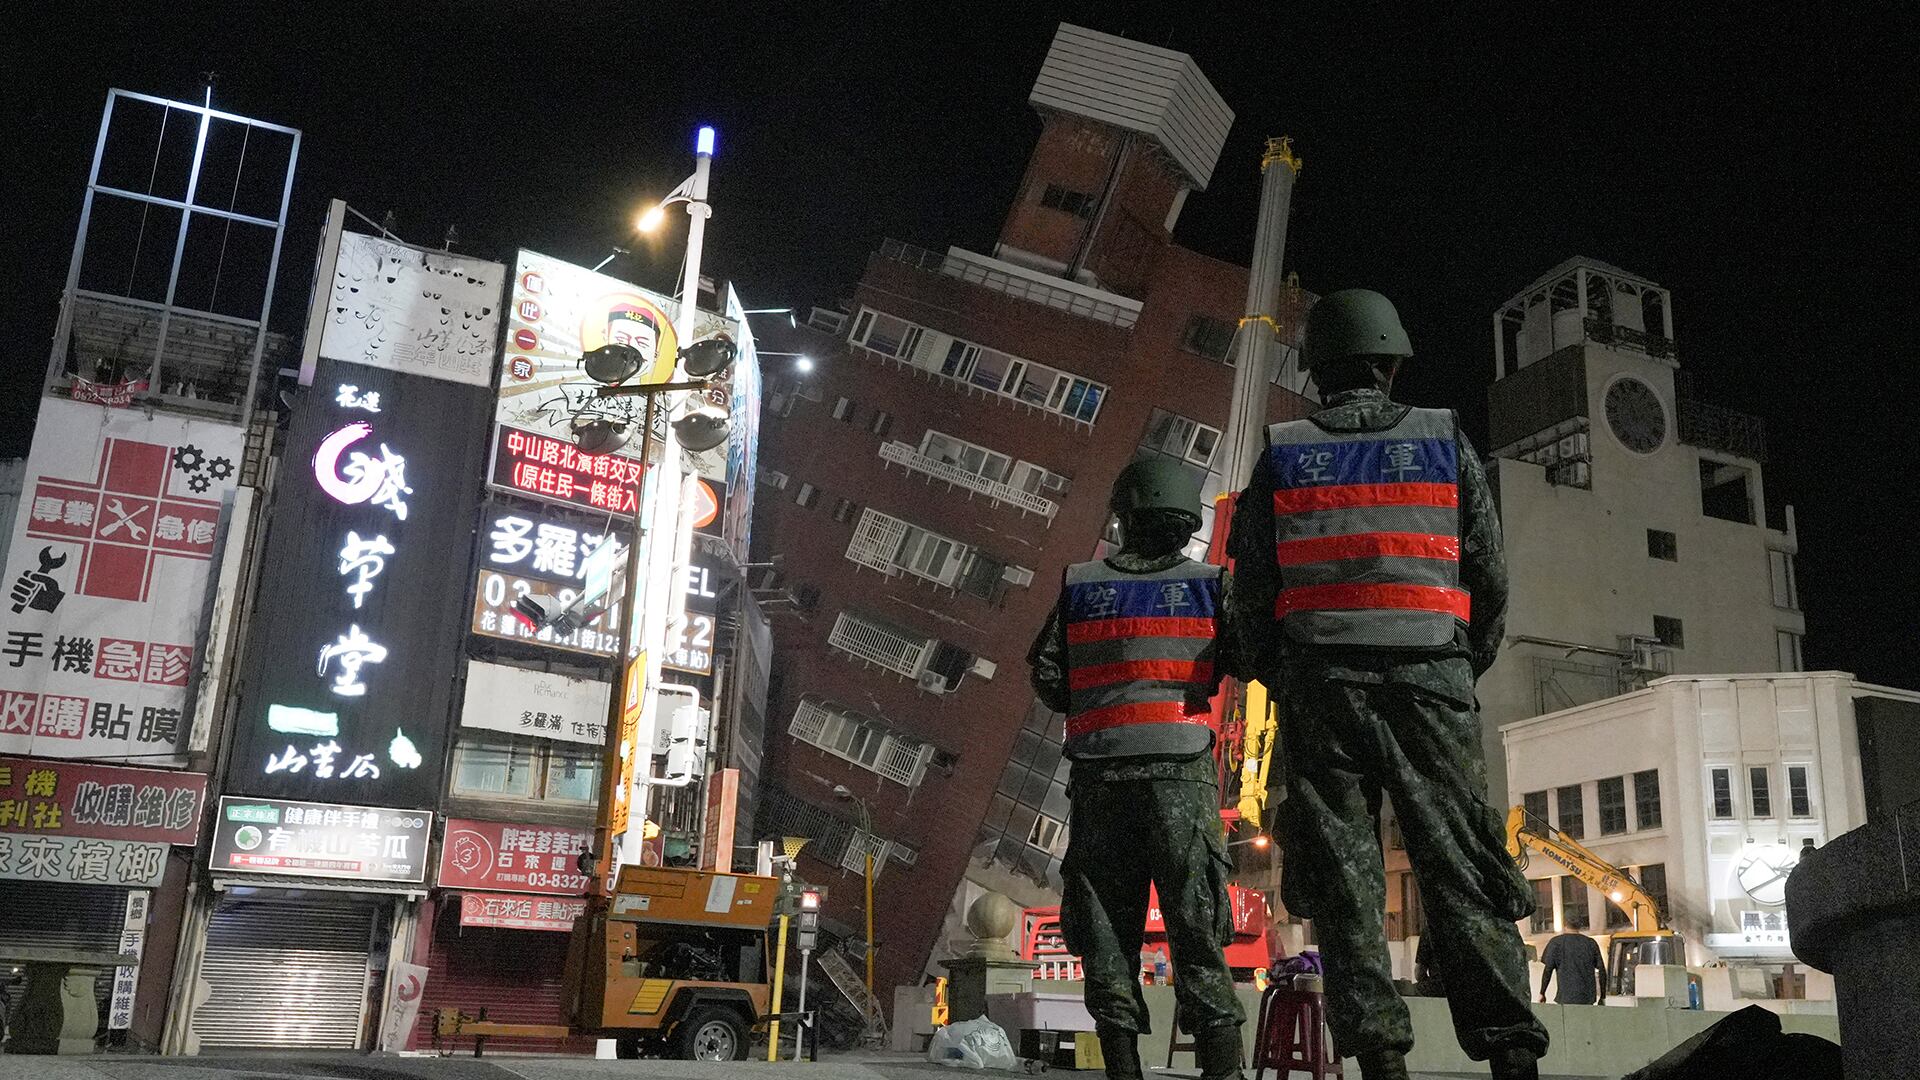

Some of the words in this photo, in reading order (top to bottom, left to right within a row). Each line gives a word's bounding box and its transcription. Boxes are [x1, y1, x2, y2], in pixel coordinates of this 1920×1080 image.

[1298, 442, 1424, 482] 空軍
[31, 496, 96, 527] 專業
[156, 514, 217, 544] 急修
[1085, 581, 1189, 619] 空軍
[2, 631, 192, 683] 手機急診
[0, 692, 182, 745] 收購貼膜
[520, 710, 564, 733] 多羅滿
[264, 740, 381, 779] 山苦瓜
[72, 781, 196, 829] 收購維修
[284, 806, 380, 830] 健康伴手禮
[1541, 846, 1582, 876] KOMATSU
[484, 897, 533, 919] 石來店
[1743, 912, 1787, 931] 黑金
